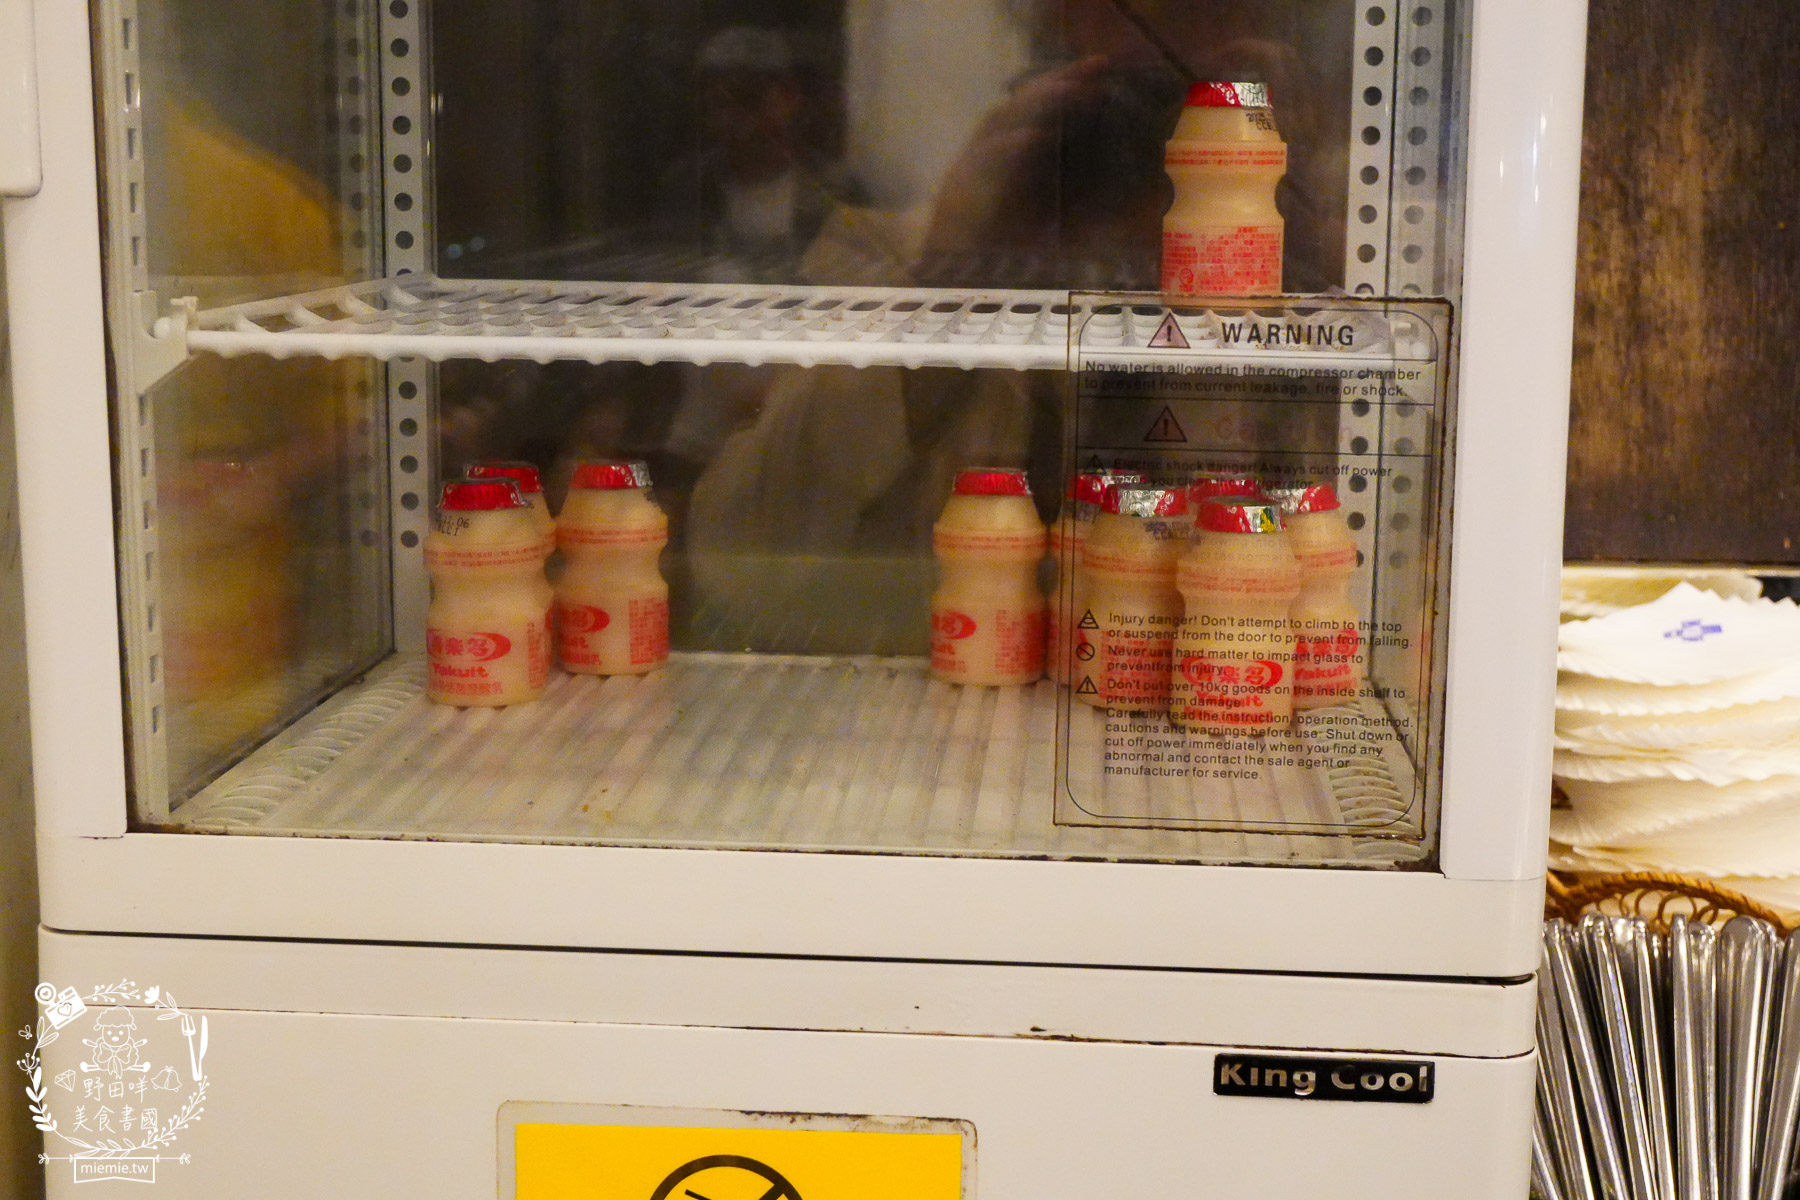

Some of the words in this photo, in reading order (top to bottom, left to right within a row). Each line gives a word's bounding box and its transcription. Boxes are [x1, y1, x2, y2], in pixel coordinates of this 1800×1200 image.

[1221, 322, 1354, 346] WARNING
[1085, 360, 1105, 372] No
[1108, 361, 1149, 373] water
[1152, 362, 1164, 373] is
[1167, 362, 1222, 375] allowed
[1226, 364, 1239, 375] in
[1243, 365, 1265, 376] the
[1268, 366, 1354, 380] compressor
[1357, 367, 1421, 380] chamber
[1084, 377, 1098, 389] to
[1100, 379, 1155, 391] prevent
[1159, 379, 1192, 391] from
[1195, 380, 1246, 392] current
[1316, 382, 1340, 394] fire
[1342, 384, 1358, 395] or
[1164, 460, 1205, 473] shock
[1258, 462, 1305, 477] Always
[1309, 464, 1330, 475] cut
[1334, 464, 1350, 476] off
[1352, 467, 1392, 480] power
[1108, 612, 1145, 627] Injury
[1147, 613, 1198, 628] danger!
[1201, 615, 1235, 627] Don't
[1238, 616, 1287, 632] attempt
[1289, 618, 1302, 629] to
[1305, 619, 1340, 630] climb
[1343, 620, 1355, 631] to
[1358, 620, 1379, 632] the
[1381, 621, 1403, 634] top
[1108, 629, 1121, 638] or
[1124, 629, 1179, 641] suspend
[1182, 629, 1211, 641] from
[1214, 631, 1234, 642] the
[1237, 631, 1267, 642] door
[1270, 633, 1282, 643] to
[1285, 634, 1334, 647] prevent
[1337, 634, 1366, 646] from
[1107, 645, 1146, 657] Never
[1149, 648, 1173, 658] use
[1175, 647, 1204, 658] hard
[1207, 649, 1249, 660] matter
[1252, 650, 1265, 661] to
[1267, 650, 1311, 663] impact
[1313, 651, 1348, 665] glass
[1351, 653, 1364, 664] to
[1107, 678, 1140, 690] Don't
[1143, 680, 1164, 692] put
[1167, 683, 1195, 692] over
[1200, 682, 1229, 695] 10kg
[1232, 684, 1271, 697] goods
[1274, 686, 1290, 695] on
[1293, 685, 1314, 696] the
[1317, 686, 1355, 697] inside
[1358, 687, 1391, 698] shelf
[1393, 688, 1406, 699] to
[1106, 694, 1154, 706] prevent
[1158, 695, 1187, 706] from
[1106, 707, 1164, 722] Carefully
[1167, 710, 1195, 721] read
[1198, 711, 1219, 722] the
[1297, 714, 1358, 727] operation
[1105, 722, 1159, 734] cautions
[1162, 724, 1186, 735] and
[1250, 726, 1291, 738] before
[1326, 728, 1356, 740] Shut
[1358, 730, 1393, 741] down
[1396, 733, 1409, 742] or
[1104, 737, 1124, 747] cut
[1128, 737, 1144, 747] off
[1146, 739, 1186, 750] power
[1188, 740, 1266, 754] immediately
[1269, 742, 1303, 753] when
[1306, 745, 1329, 756] you
[1333, 743, 1357, 754] find
[1360, 746, 1384, 757] any
[1104, 751, 1164, 762] abnormal
[1167, 752, 1191, 763] and
[1194, 754, 1242, 765] contact
[1244, 755, 1265, 766] the
[1267, 756, 1294, 767] sale
[1297, 758, 1333, 770] agent
[1336, 760, 1350, 768] or
[1104, 765, 1190, 777] manufacturer
[1192, 767, 1210, 777] for
[1220, 1063, 1316, 1096] King
[1331, 1064, 1428, 1092] Cool
